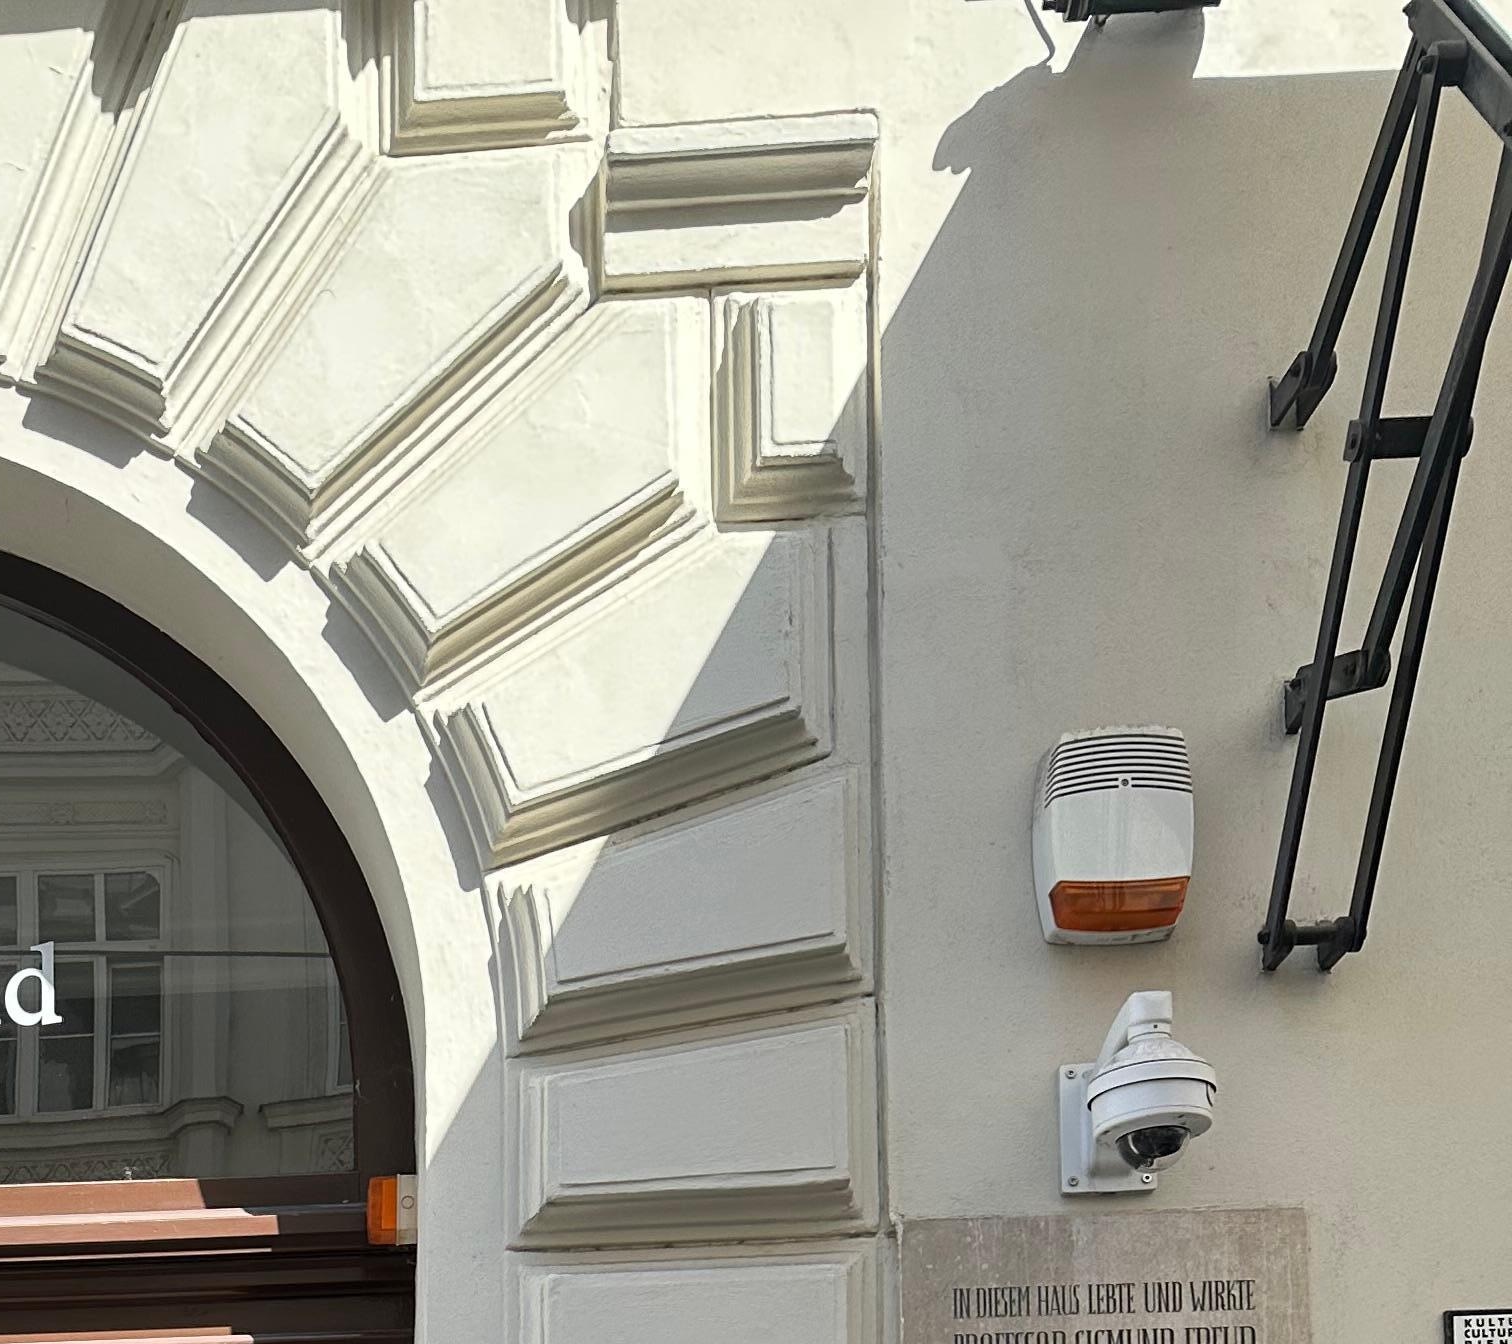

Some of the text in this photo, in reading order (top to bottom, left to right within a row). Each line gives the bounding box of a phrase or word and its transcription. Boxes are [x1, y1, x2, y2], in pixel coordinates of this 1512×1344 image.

[953, 1279, 1256, 1320] IN DIESEM HAUS LEBTE UND WIRKTE
